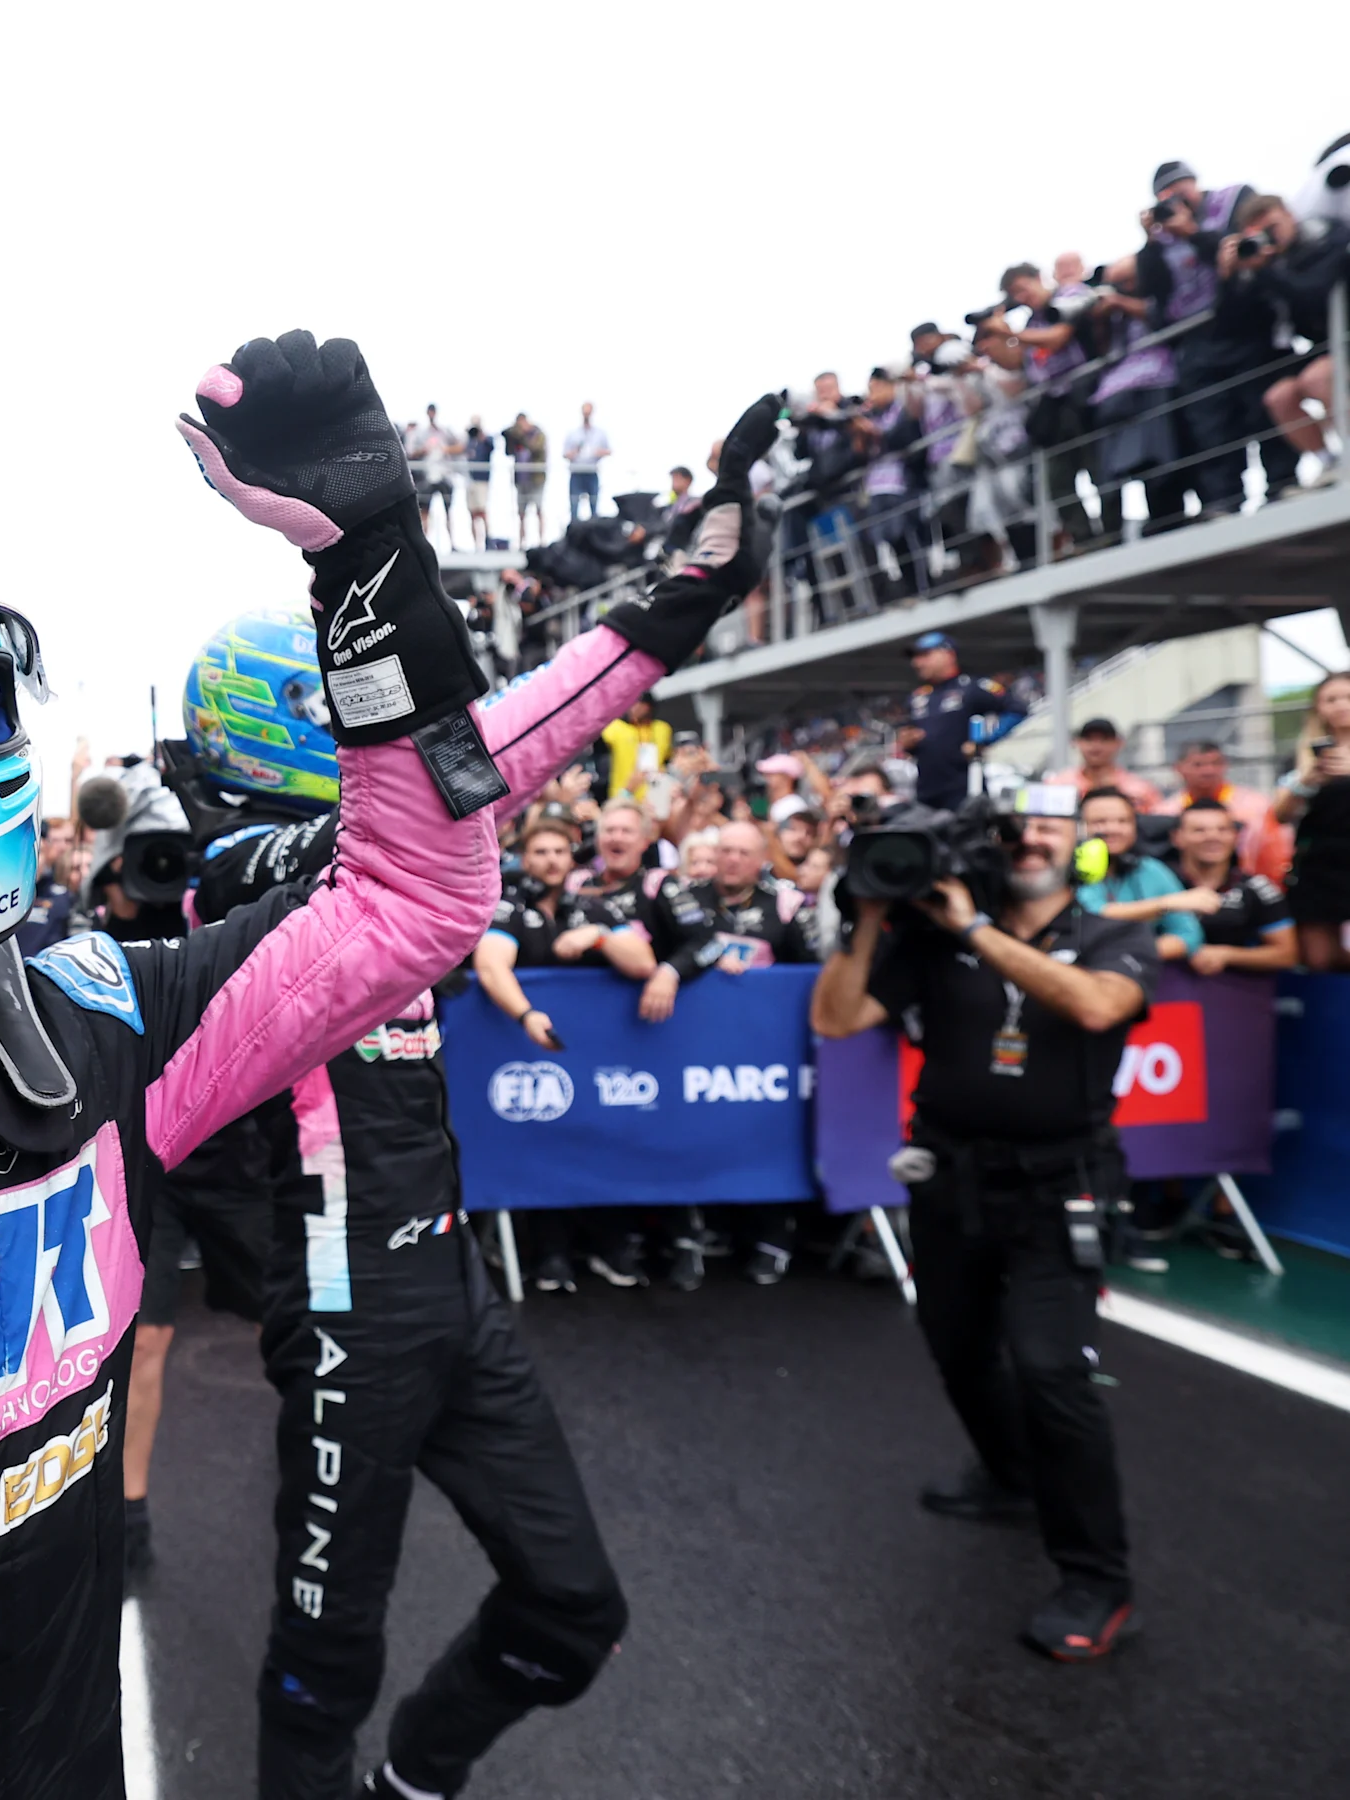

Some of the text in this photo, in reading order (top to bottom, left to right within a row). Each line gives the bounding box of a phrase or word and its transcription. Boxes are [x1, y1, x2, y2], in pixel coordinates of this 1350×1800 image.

[332, 620, 398, 667] One Vision.
[497, 1074, 566, 1110] FIA
[682, 1064, 789, 1103] PARC
[292, 1324, 349, 1621] ALPINE
